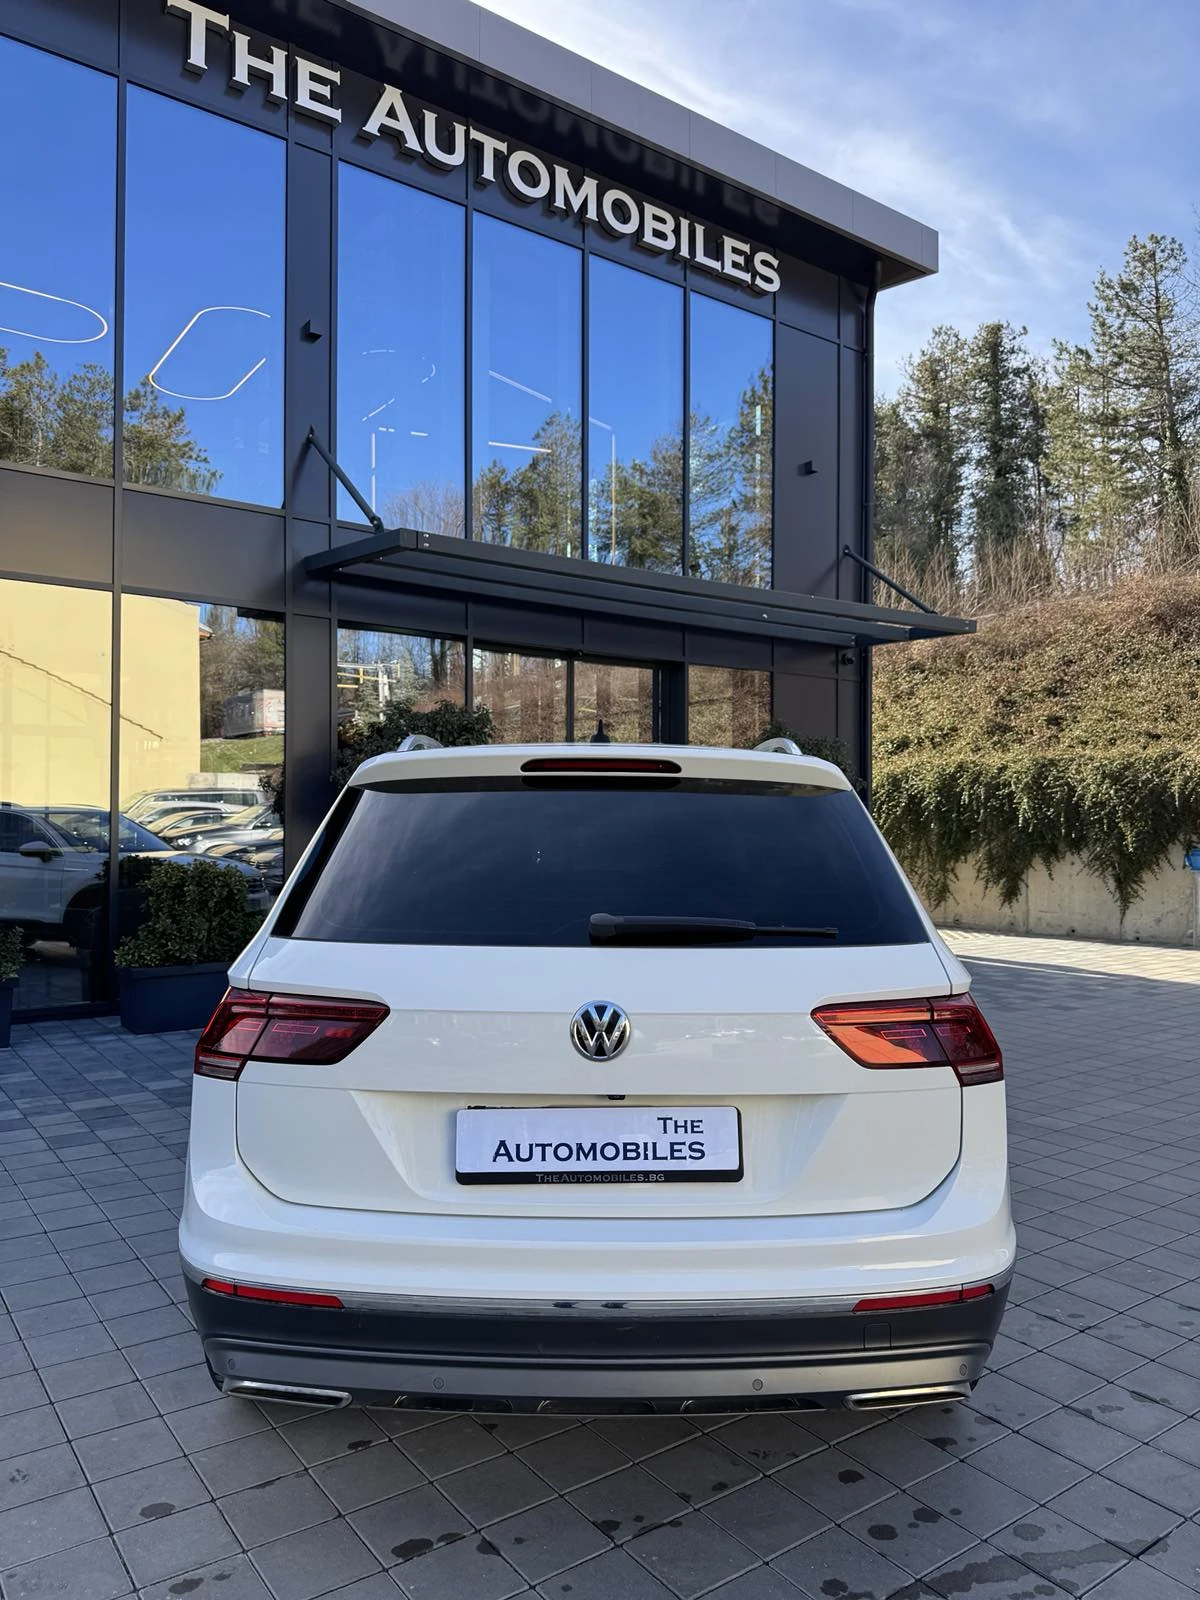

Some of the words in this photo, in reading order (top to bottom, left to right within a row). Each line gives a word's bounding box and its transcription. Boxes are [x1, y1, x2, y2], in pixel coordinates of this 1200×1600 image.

[167, 0, 342, 123] THE
[362, 83, 781, 293] AUTOMOBILES
[657, 1117, 704, 1135] THE
[492, 1139, 706, 1162] AUTOMOBILES
